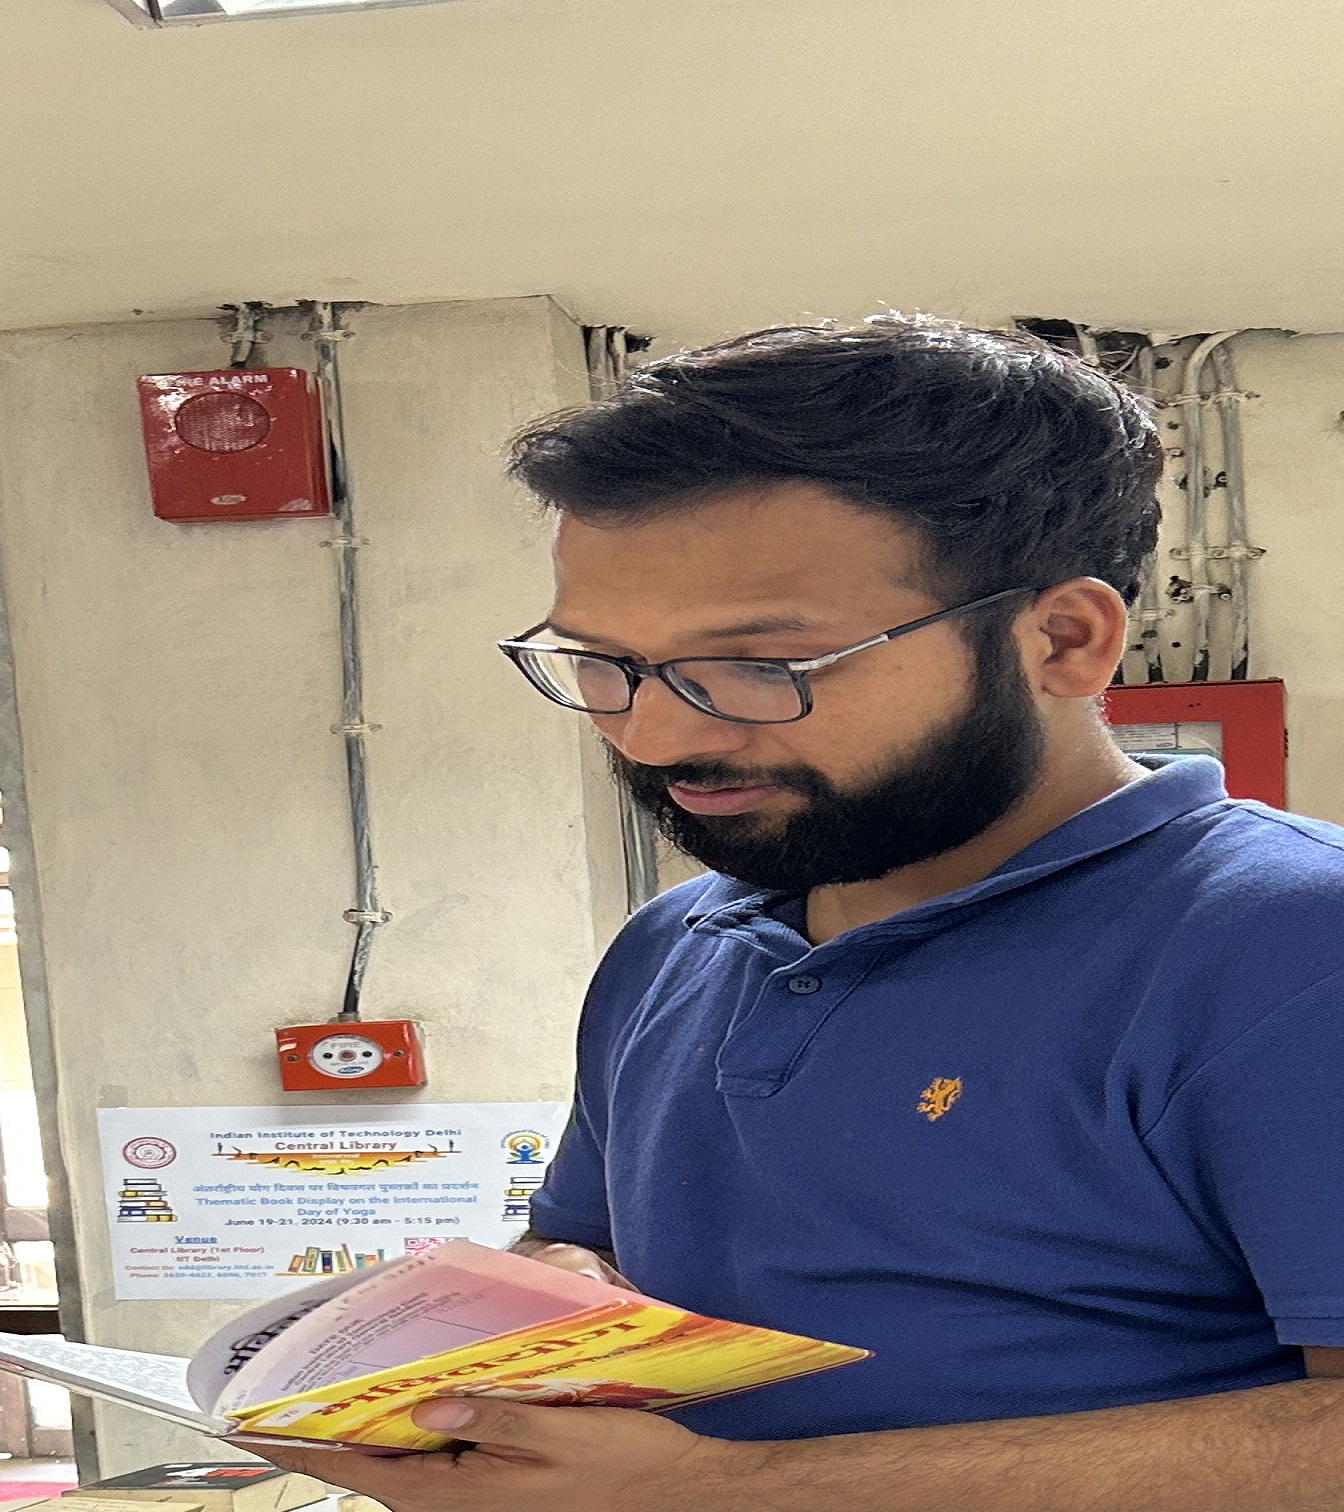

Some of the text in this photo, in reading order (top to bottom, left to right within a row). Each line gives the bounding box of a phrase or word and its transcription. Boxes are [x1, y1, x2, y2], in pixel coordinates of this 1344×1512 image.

[209, 375, 268, 386] ALARM
[210, 1129, 462, 1140] Indian Institute of Technology Delhi
[275, 1141, 397, 1151] Central Library
[195, 1198, 256, 1206] Thematic
[260, 1197, 294, 1206] Book
[297, 1197, 346, 1207] Display
[369, 1196, 390, 1204] the
[394, 1195, 477, 1204] International
[297, 1208, 376, 1217] Day of Yoga
[224, 1218, 255, 1226] June
[302, 1217, 332, 1226] 2024
[337, 1217, 369, 1226] (9:30
[404, 1217, 432, 1225] 5:15
[435, 1217, 460, 1226] pm)
[174, 1235, 218, 1244] Venue
[319, 1319, 644, 1417] भक्तियोग
